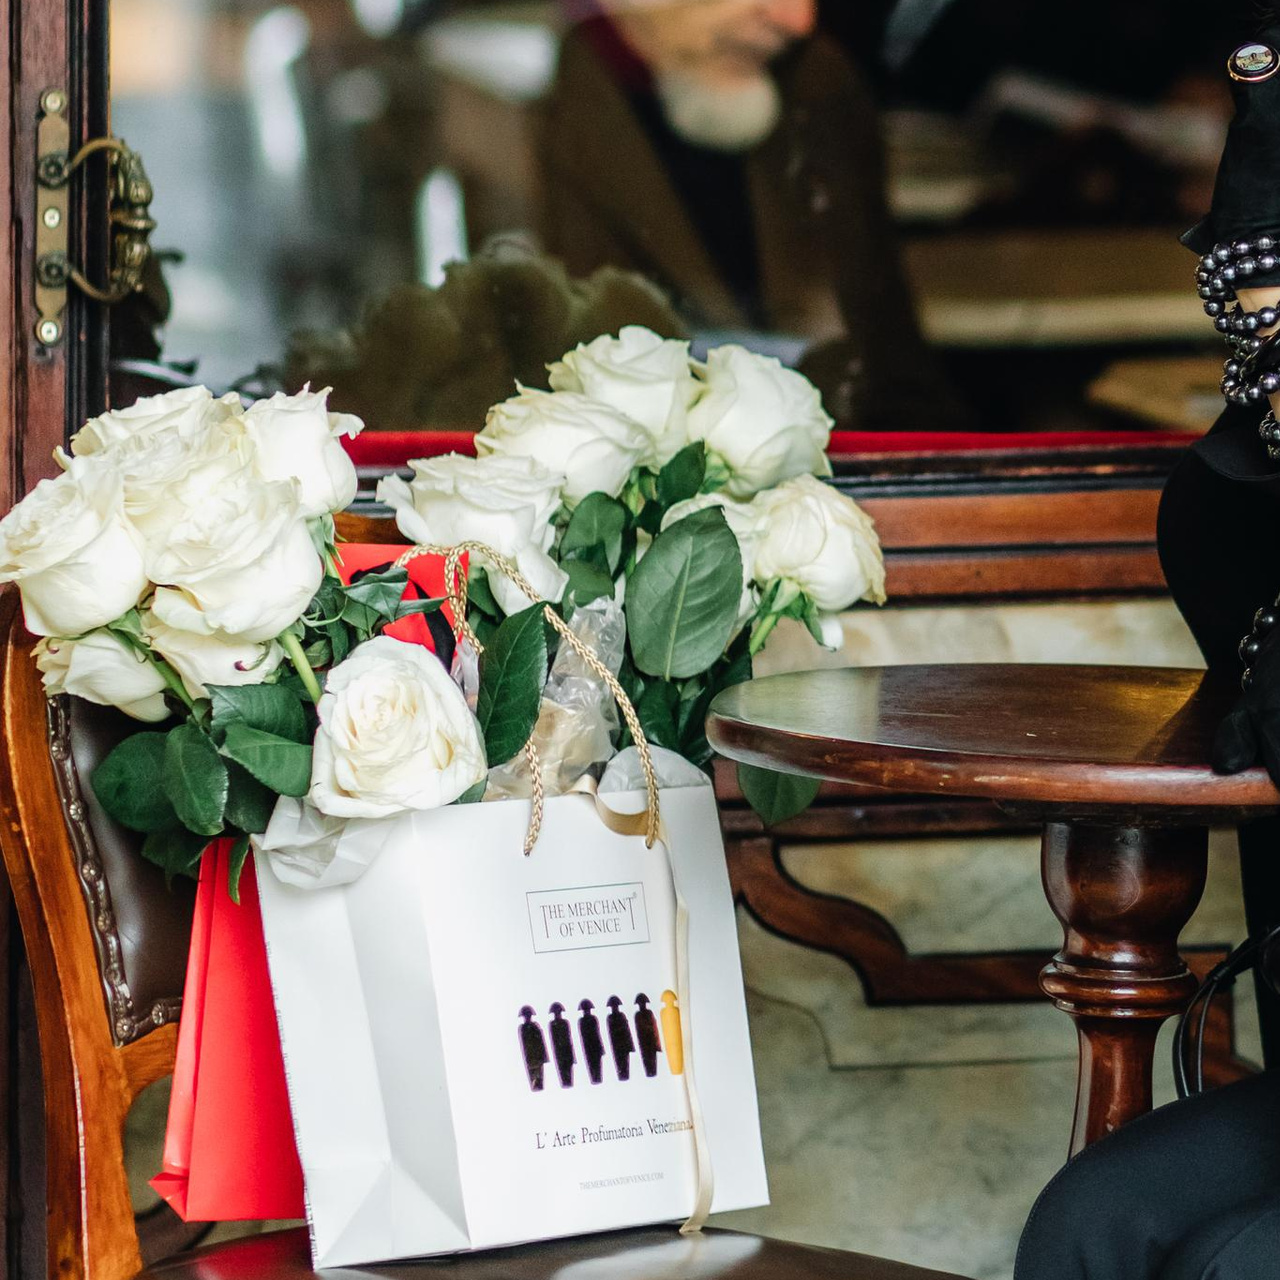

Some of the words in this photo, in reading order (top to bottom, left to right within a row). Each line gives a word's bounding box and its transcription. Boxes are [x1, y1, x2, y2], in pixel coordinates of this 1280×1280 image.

[540, 904, 565, 938] THE
[559, 922, 574, 937] OF
[577, 918, 621, 935] VENICE
[553, 1131, 576, 1147] Arte
[581, 1125, 643, 1144] Profumatoria
